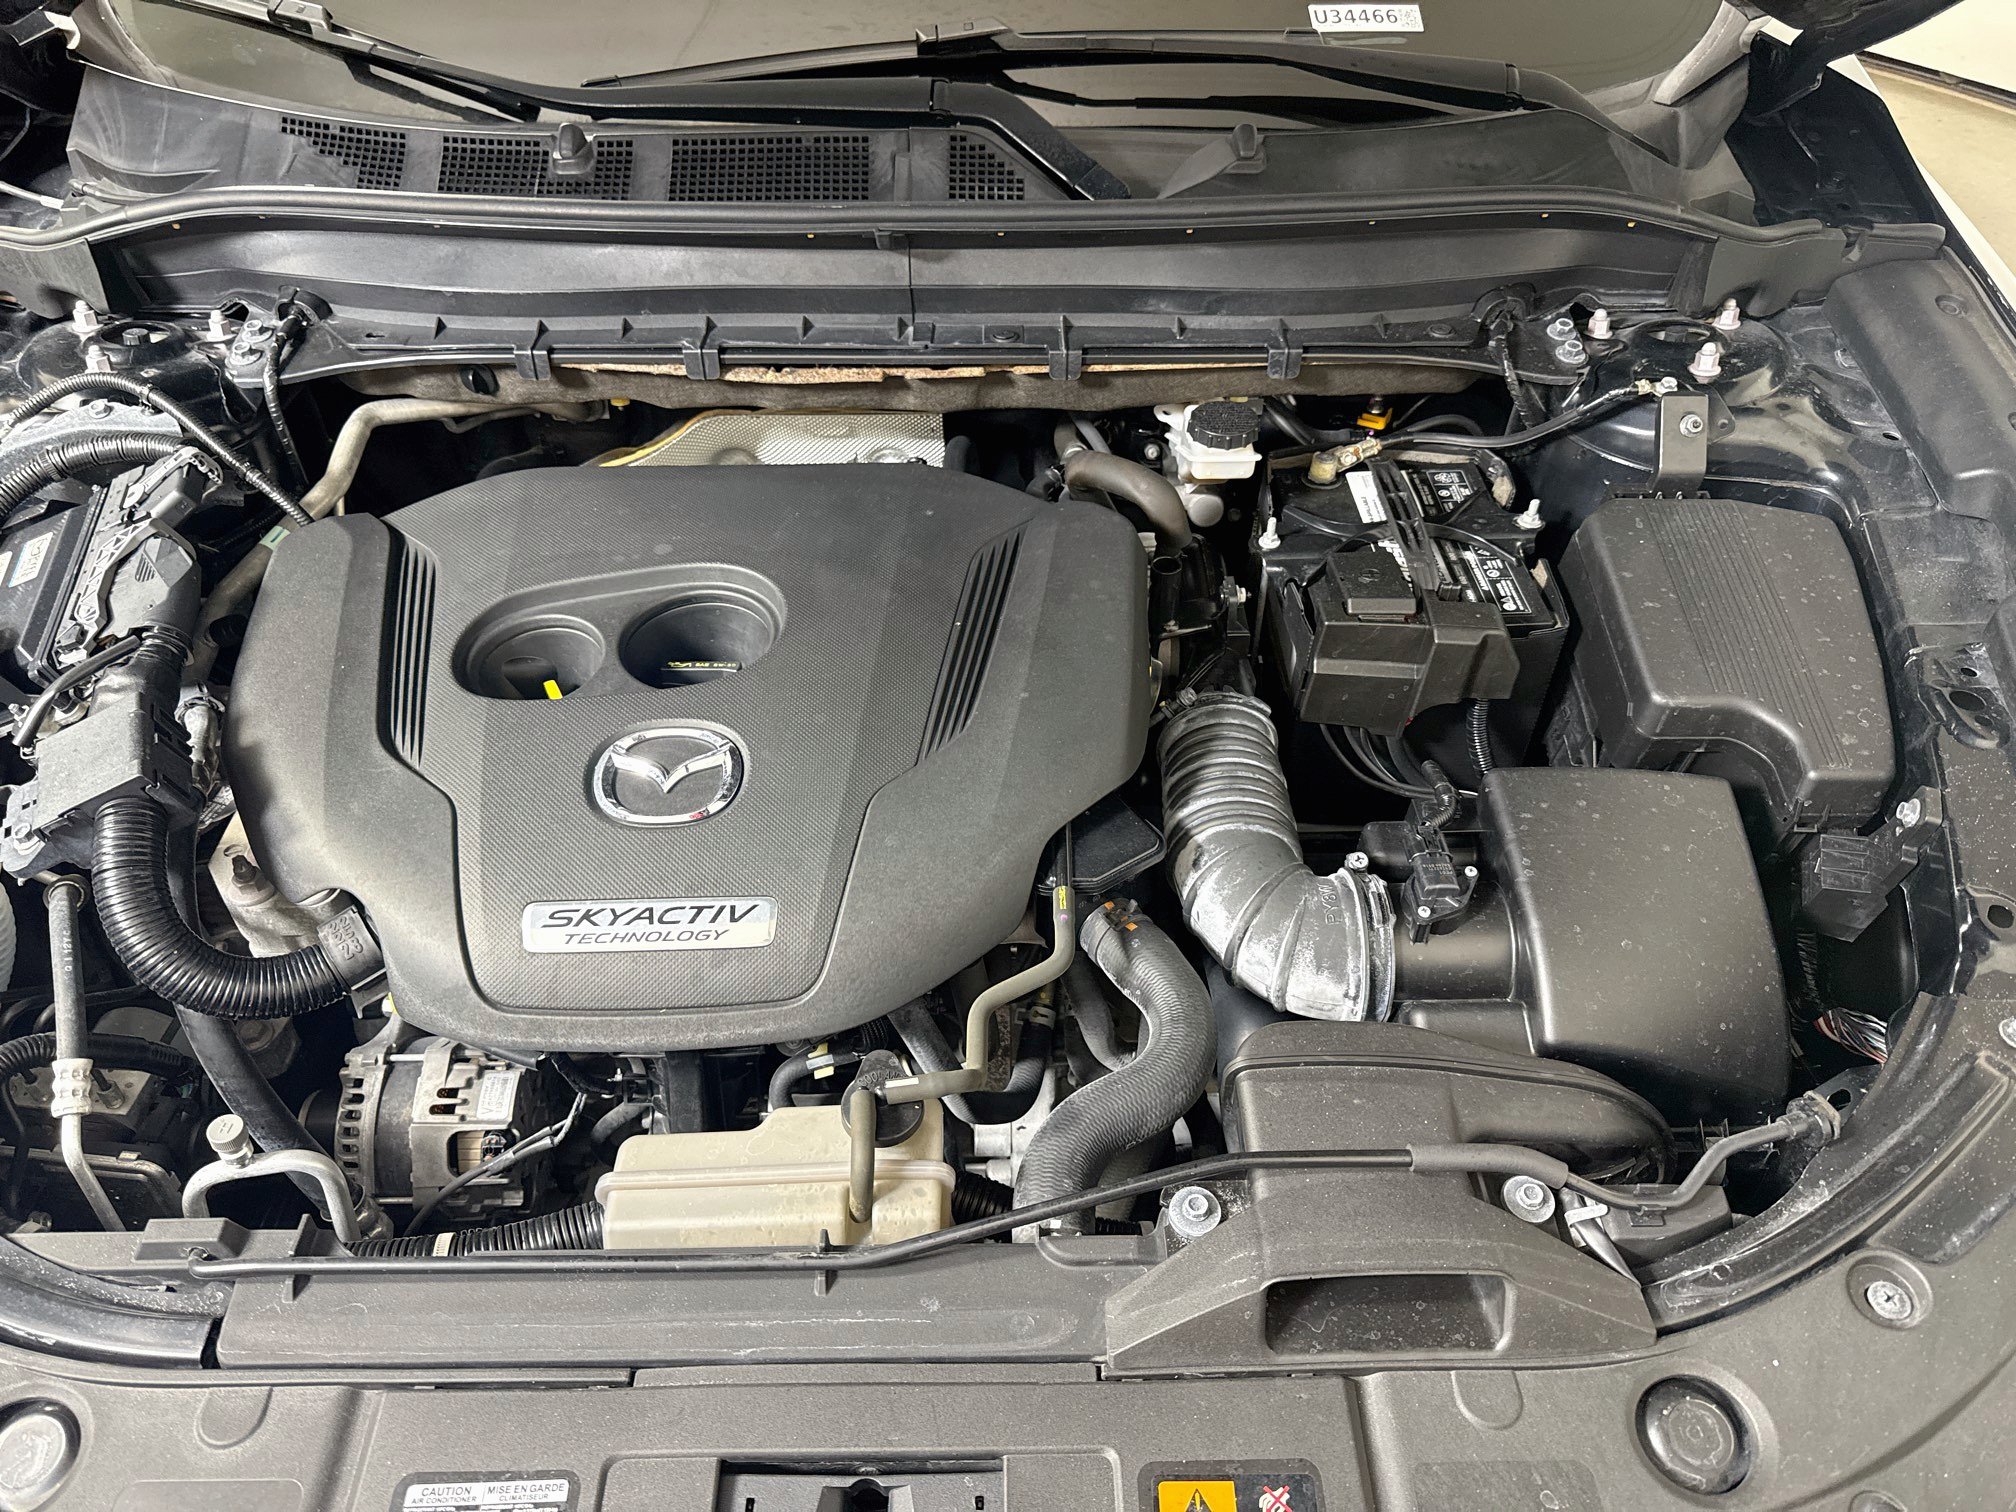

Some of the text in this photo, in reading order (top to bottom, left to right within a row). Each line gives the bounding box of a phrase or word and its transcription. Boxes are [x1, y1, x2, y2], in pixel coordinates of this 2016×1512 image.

[1313, 9, 1398, 24] U34466
[541, 903, 760, 929] SKYACTIV
[564, 928, 730, 945] TECHNOLOGY
[421, 1486, 472, 1497] CAUTION
[487, 1483, 566, 1495] MISE EN GARDE
[425, 1495, 477, 1504] CONDITIONER
[498, 1493, 549, 1502] CLIMATISEUR
